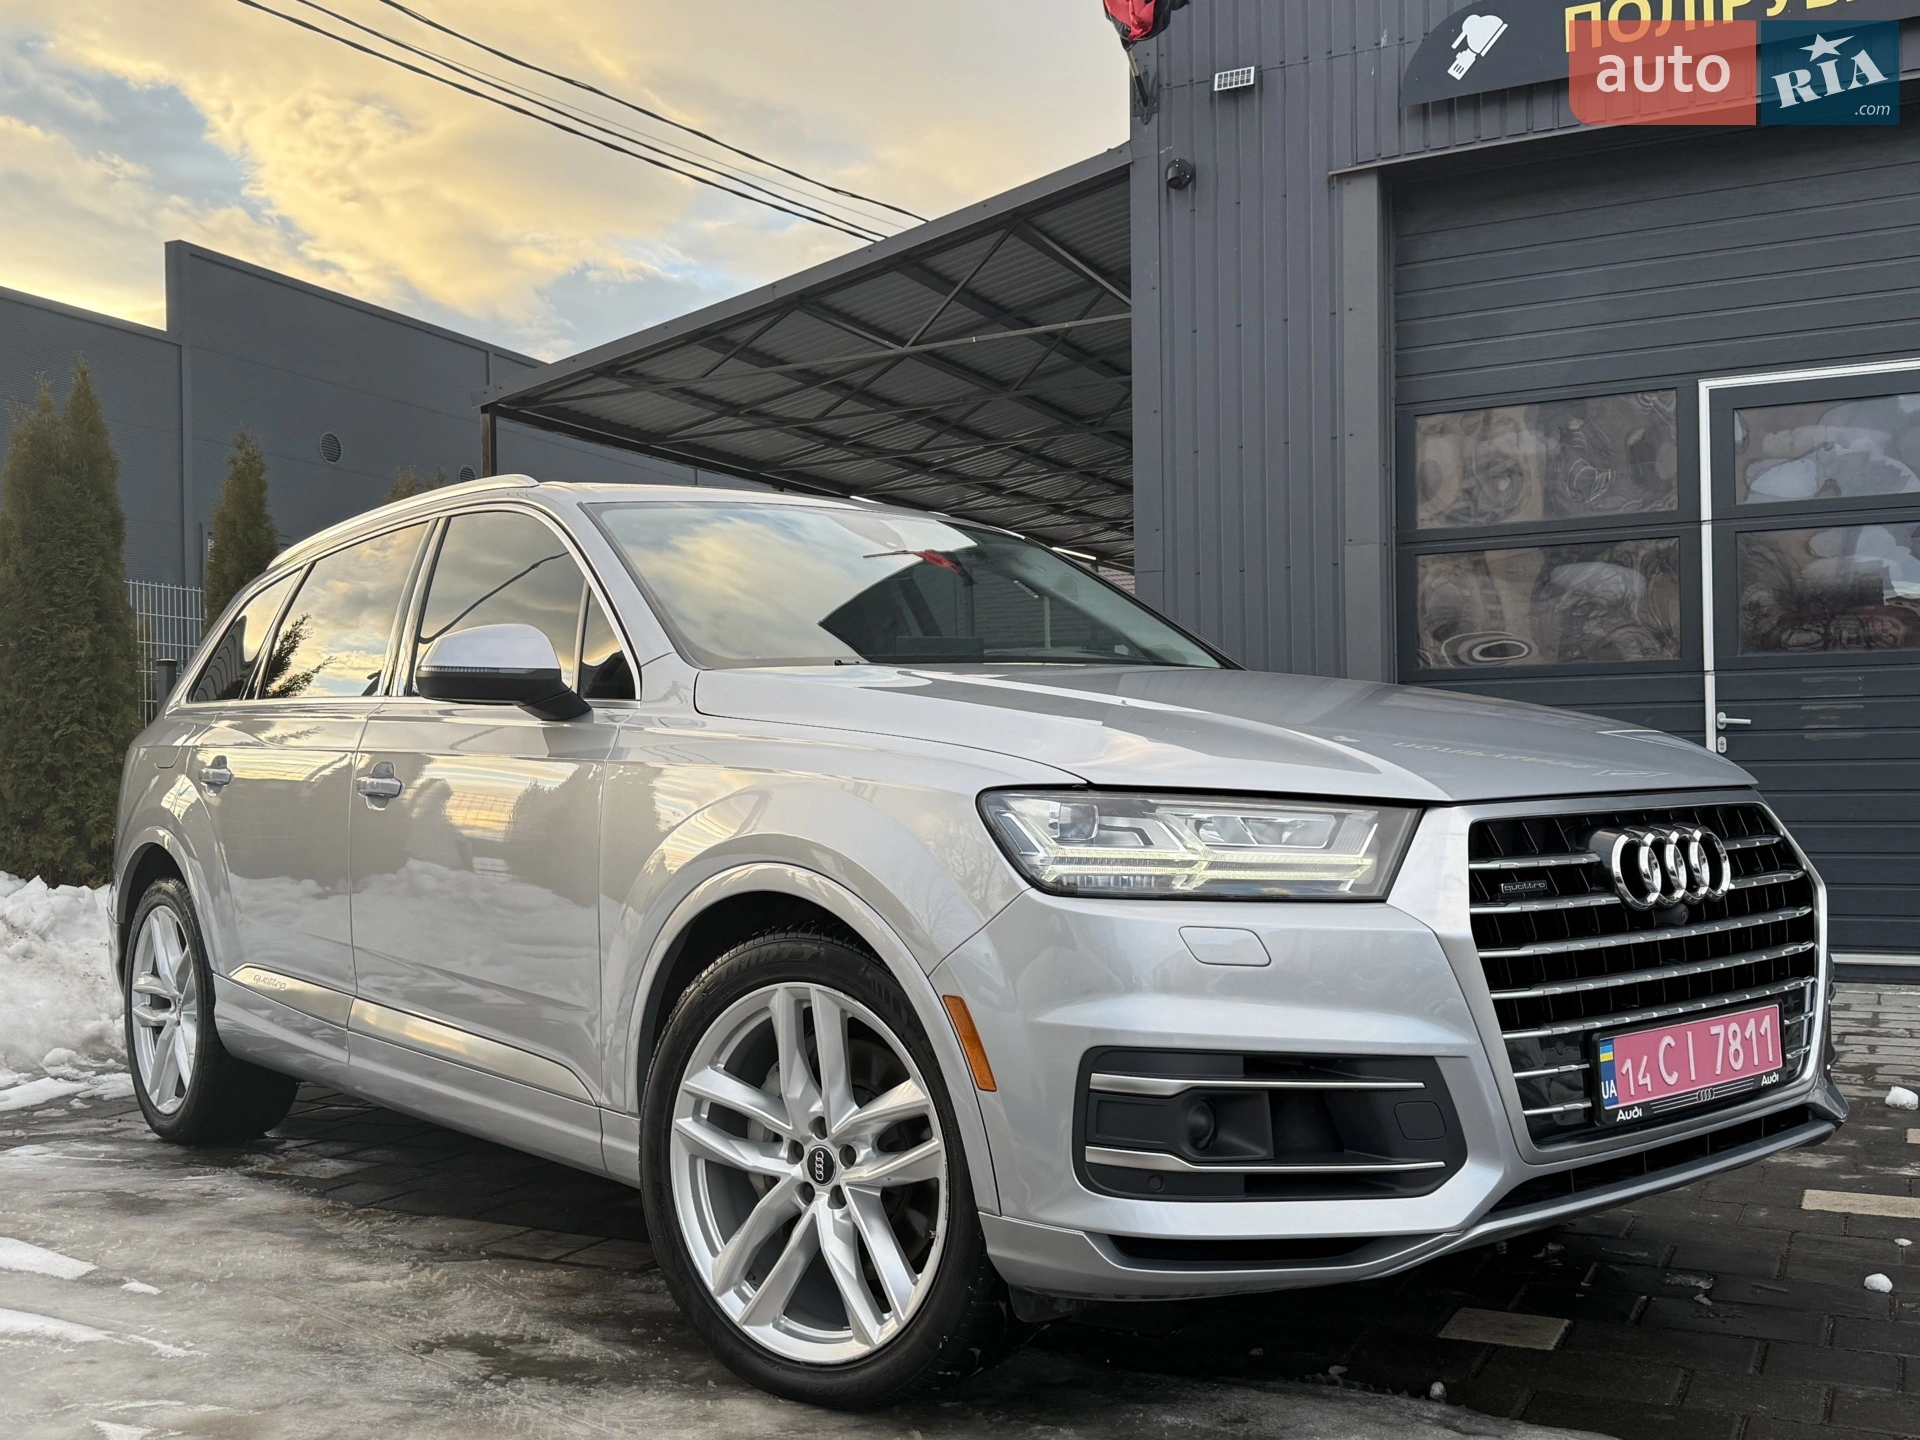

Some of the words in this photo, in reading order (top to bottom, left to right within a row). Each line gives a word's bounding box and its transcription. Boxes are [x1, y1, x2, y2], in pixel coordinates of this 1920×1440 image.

[1504, 882, 1546, 892] quattro
[253, 974, 287, 990] quattro
[1710, 1014, 1774, 1076] 7811
[1761, 1073, 1779, 1086] Audi
[1602, 1080, 1618, 1100] UA
[1616, 1106, 1643, 1122] Audi
